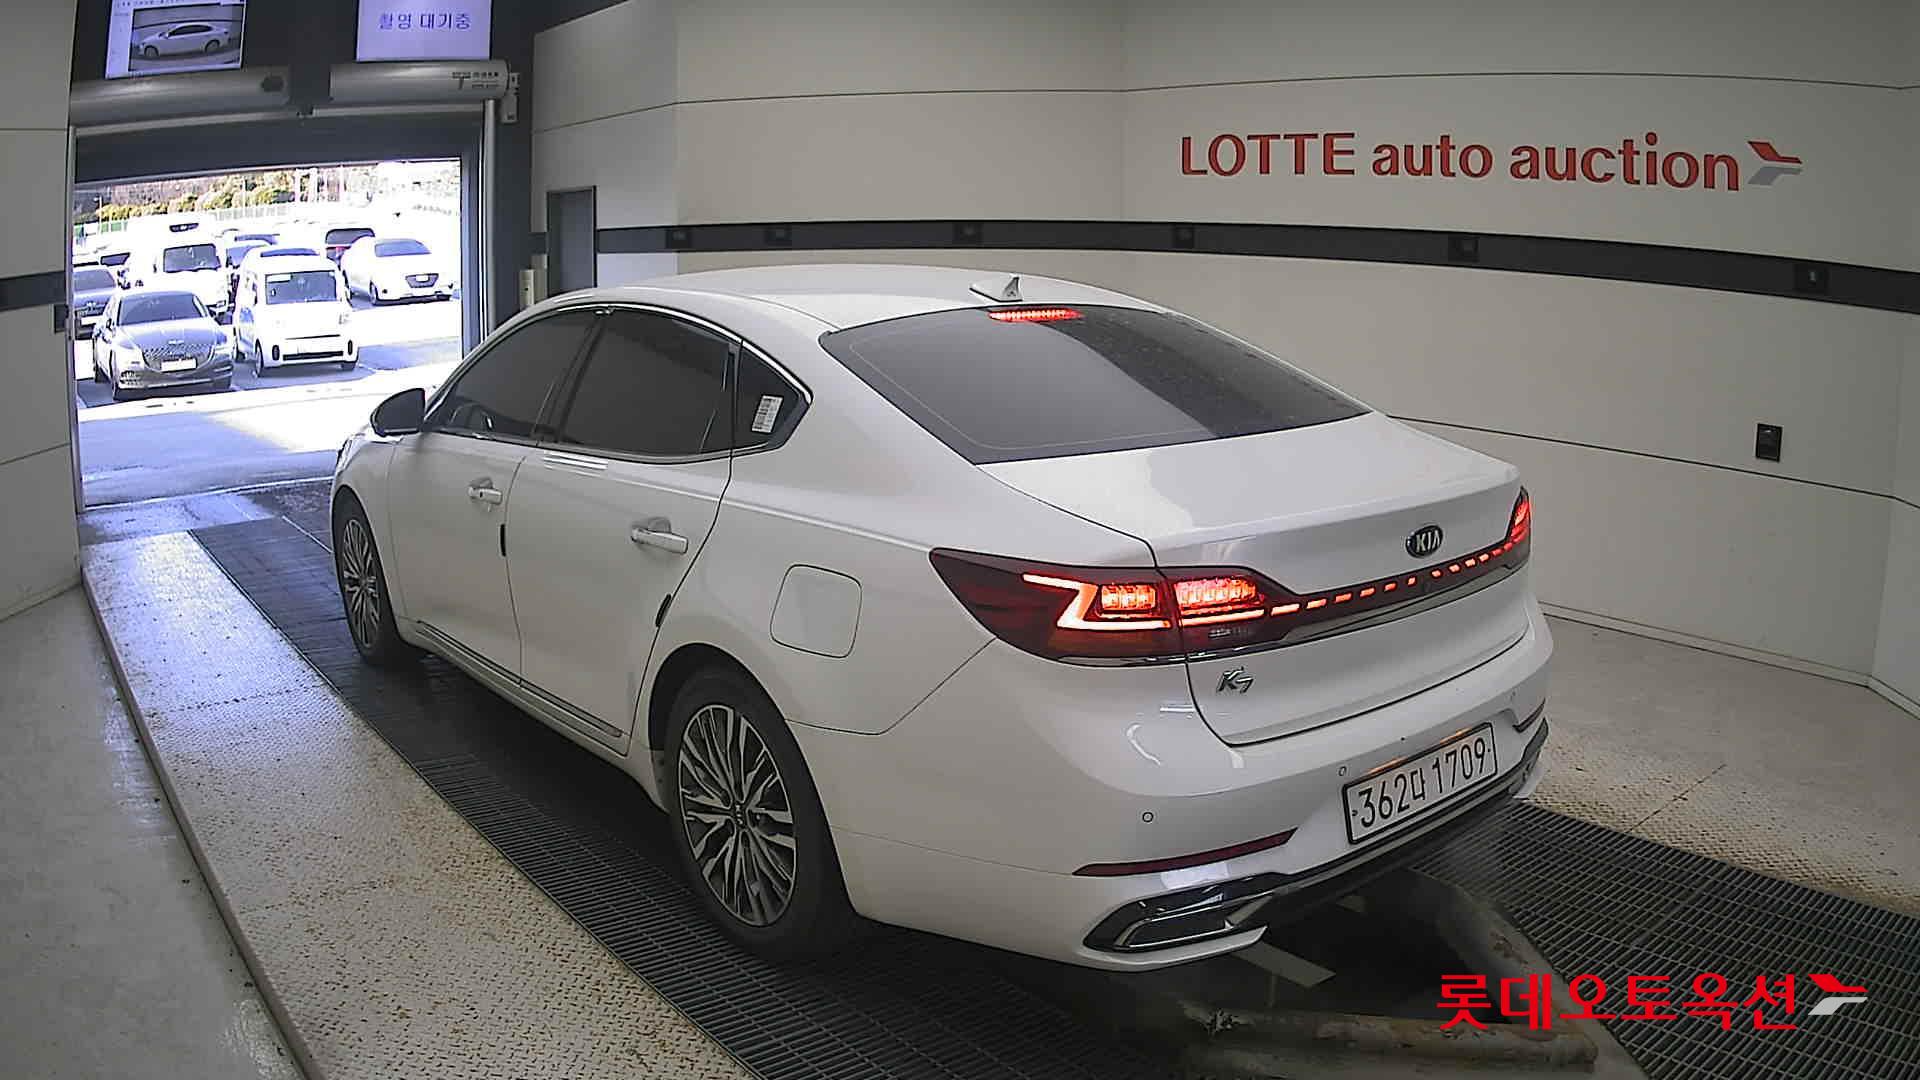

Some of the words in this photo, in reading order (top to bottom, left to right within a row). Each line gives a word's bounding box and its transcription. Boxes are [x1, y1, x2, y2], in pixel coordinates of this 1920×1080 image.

[419, 12, 471, 30] 대기중
[1181, 132, 1355, 177] LOTTE
[1372, 135, 1493, 178] auto
[1509, 132, 1740, 191] auction
[1415, 530, 1441, 552] KIA
[1217, 666, 1255, 694] K7
